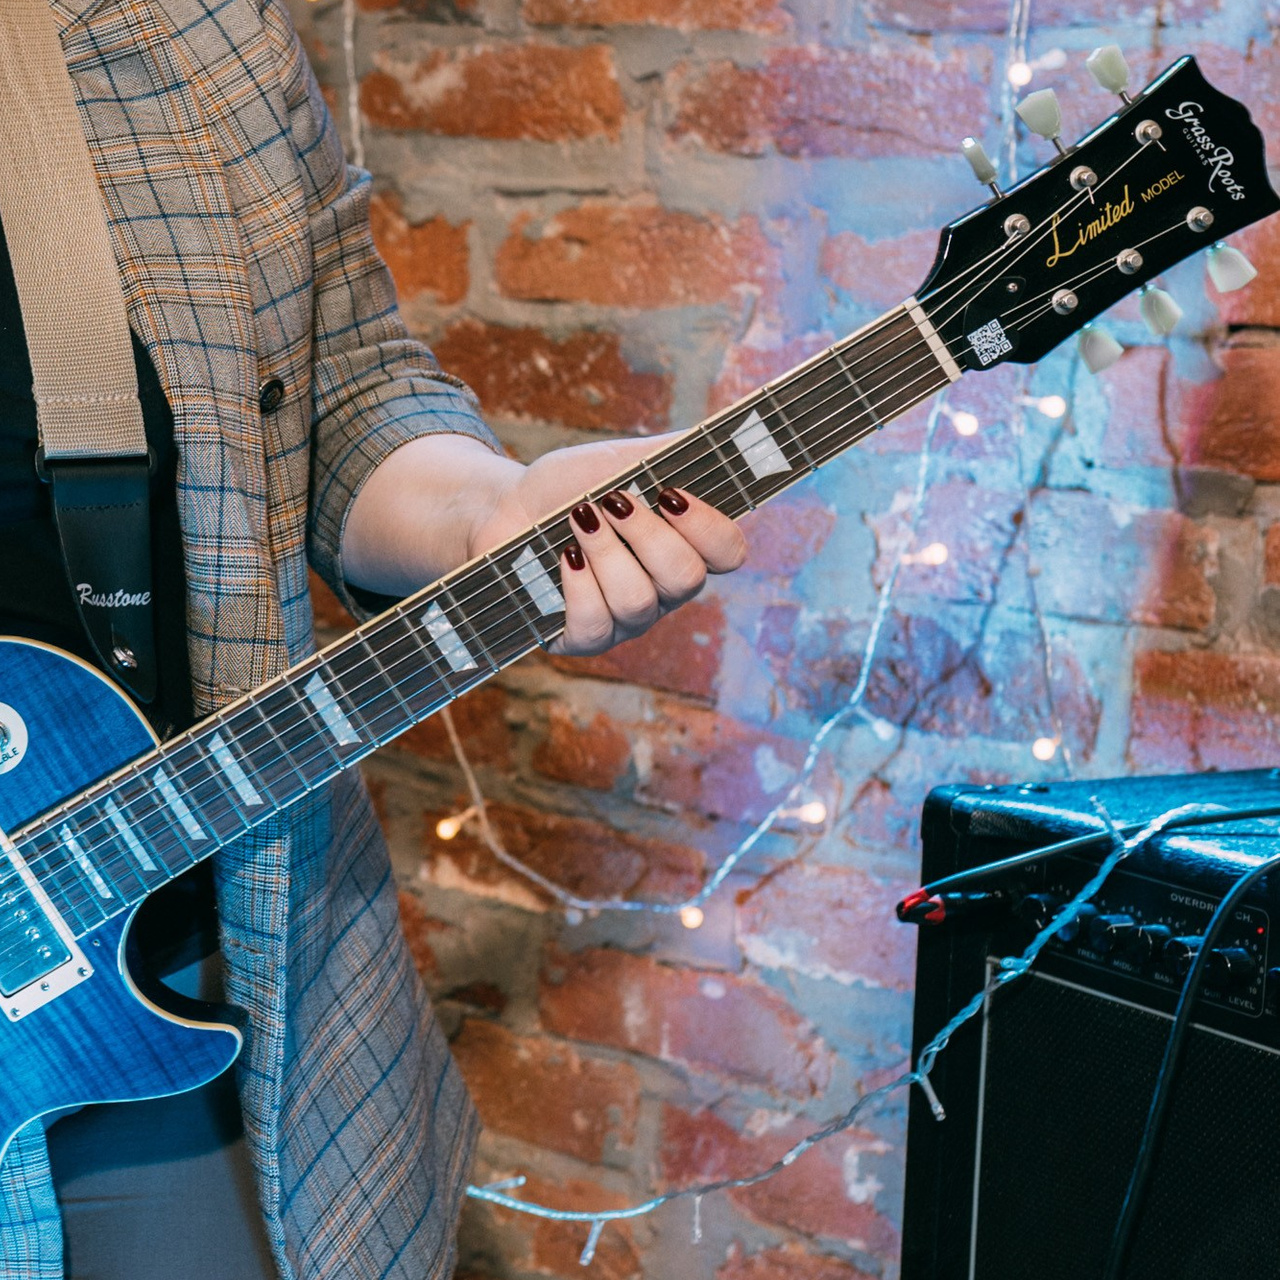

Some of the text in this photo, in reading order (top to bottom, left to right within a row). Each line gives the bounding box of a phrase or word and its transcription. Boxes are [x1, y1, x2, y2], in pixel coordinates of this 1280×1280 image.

[1182, 127, 1208, 166] GUITARS
[1046, 170, 1185, 267] Limited MODEL
[76, 583, 151, 608] Russtone
[1170, 892, 1219, 913] OVERDRI
[1228, 995, 1256, 1010] LEVEL
